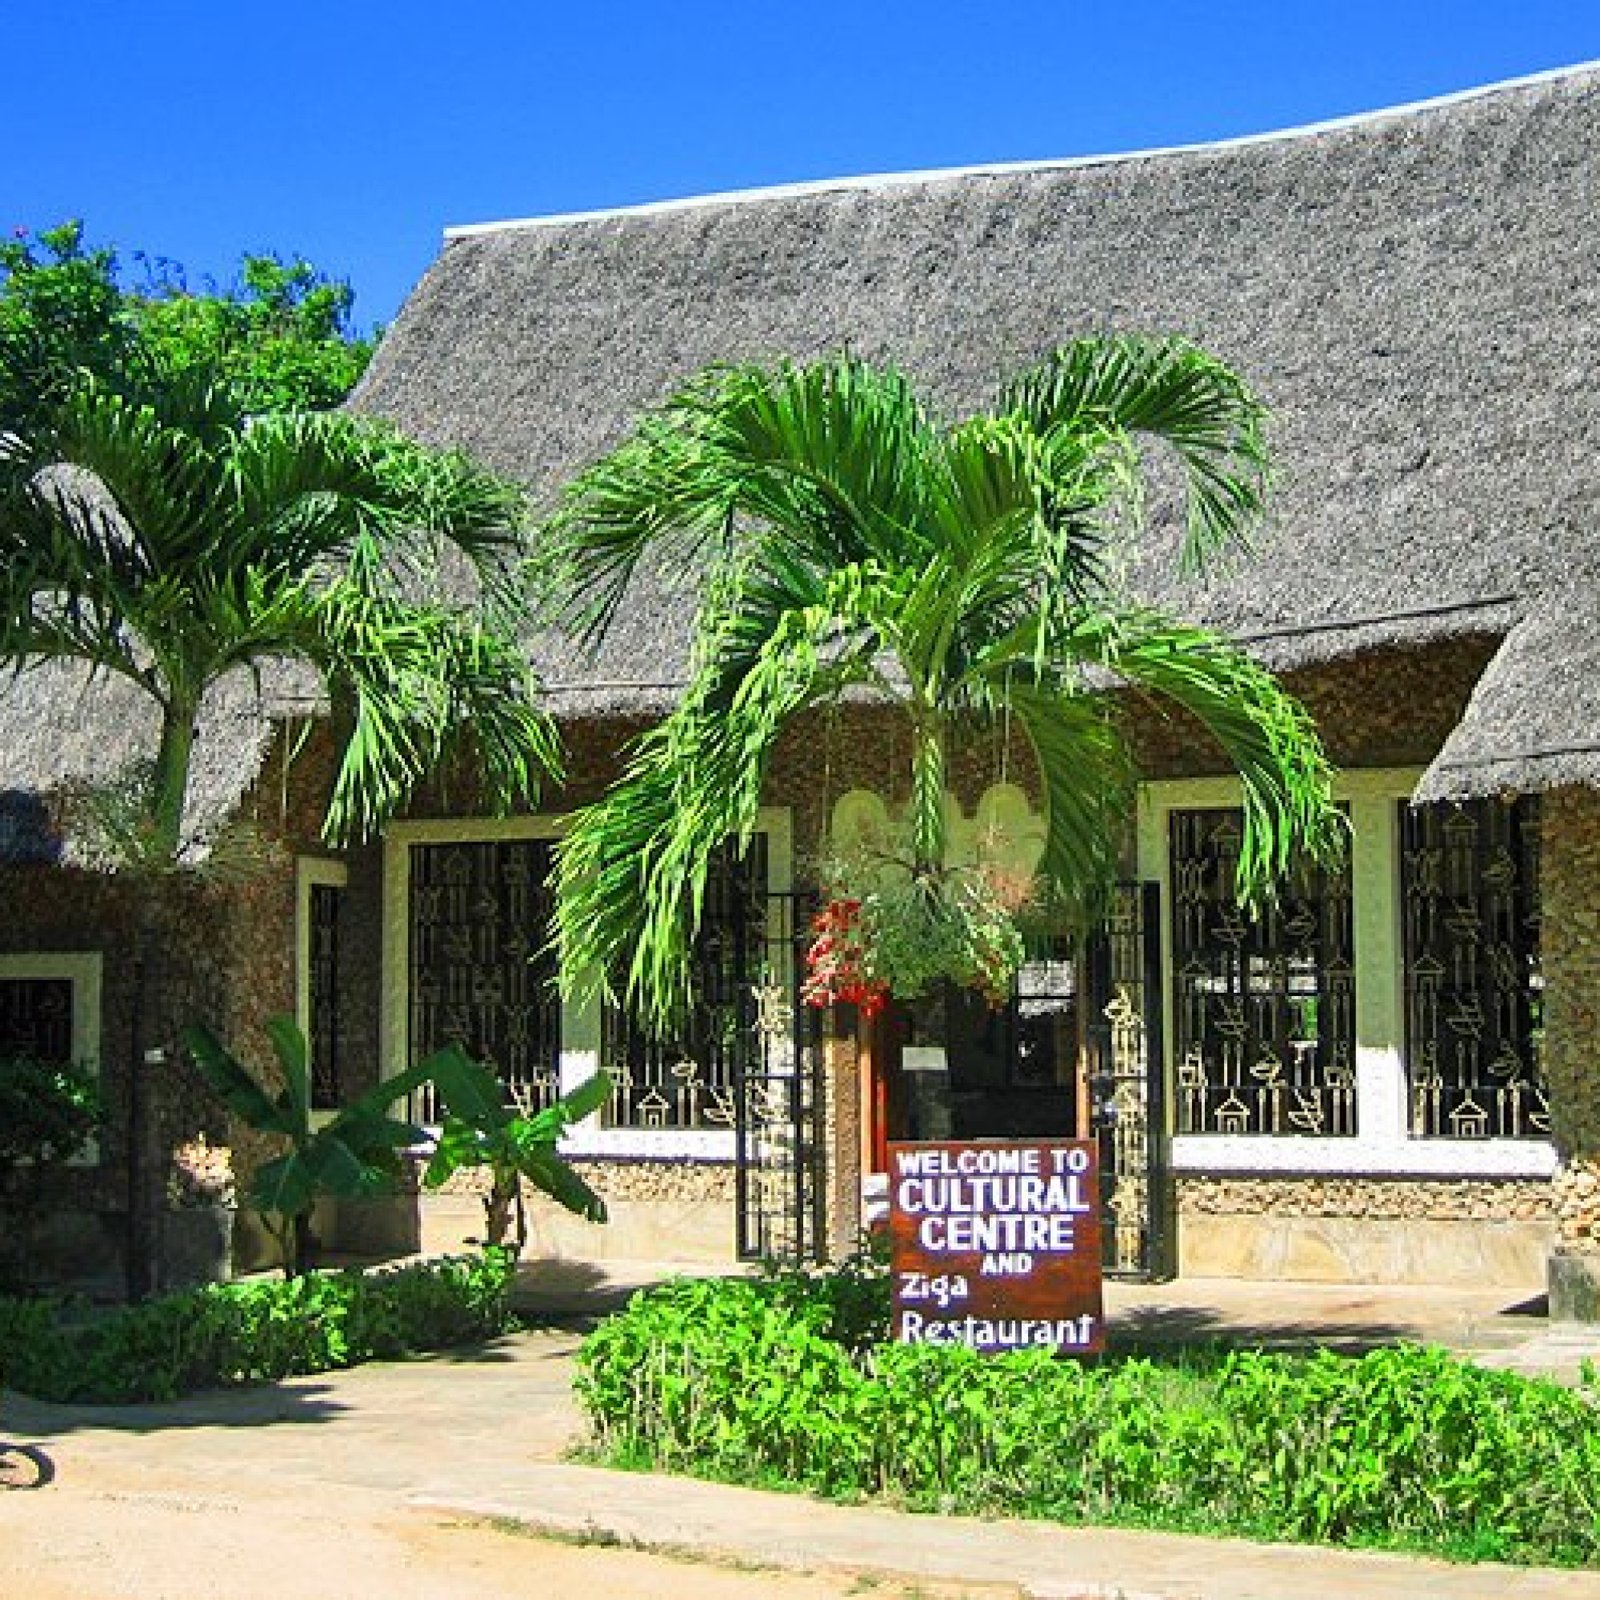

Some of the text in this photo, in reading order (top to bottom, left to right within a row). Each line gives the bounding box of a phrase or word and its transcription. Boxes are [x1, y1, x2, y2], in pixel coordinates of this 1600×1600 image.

[896, 1147, 1089, 1175] WELCOME TO
[899, 1175, 1090, 1213] CULTURAL
[921, 1214, 1074, 1250] CENTRE
[981, 1252, 1033, 1275] AND
[901, 1311, 1094, 1347] Restaurant
